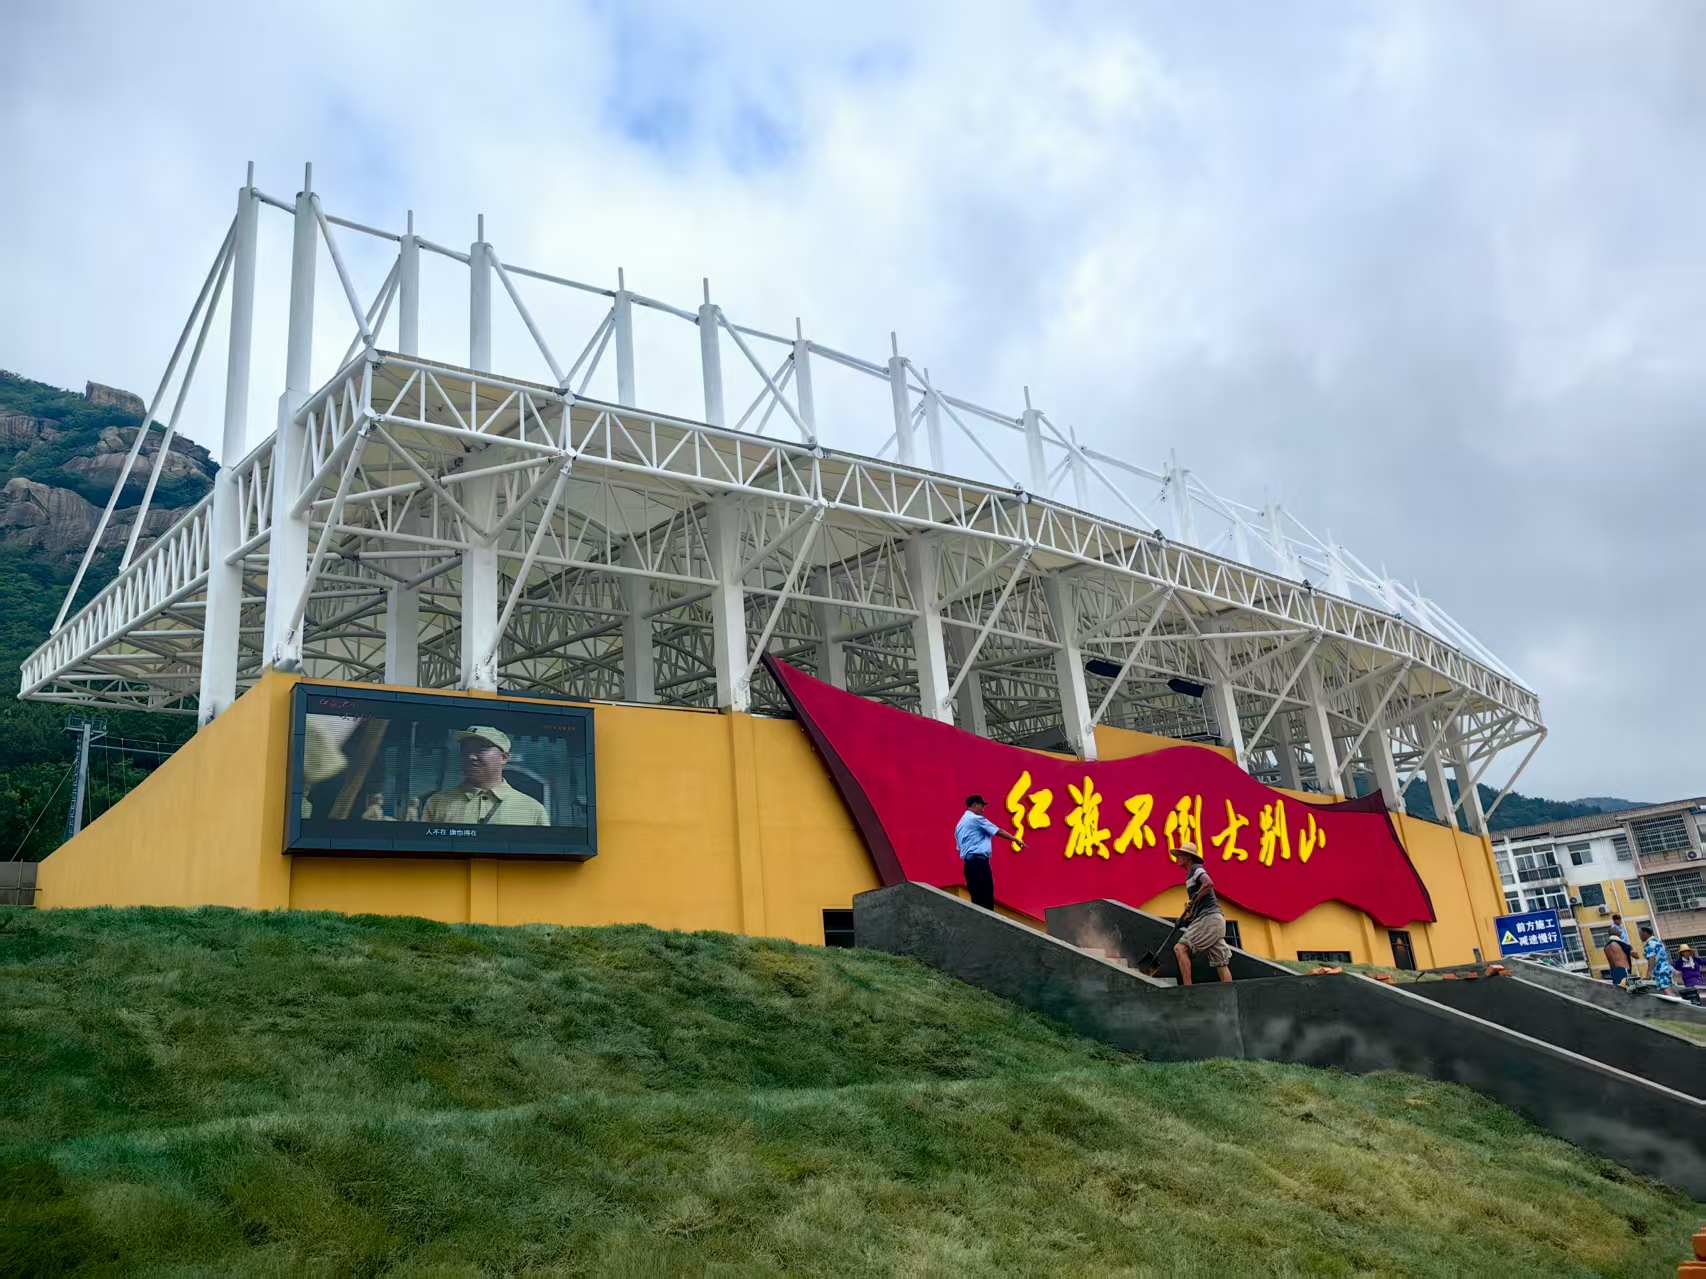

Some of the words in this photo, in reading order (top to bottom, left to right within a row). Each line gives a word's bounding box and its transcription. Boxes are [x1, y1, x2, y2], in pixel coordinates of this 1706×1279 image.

[1005, 770, 1326, 866] 红旗不倒大别山
[425, 828, 447, 836] 人不在
[1516, 918, 1555, 933] 前方施工
[1519, 931, 1557, 946] 减速慢行
